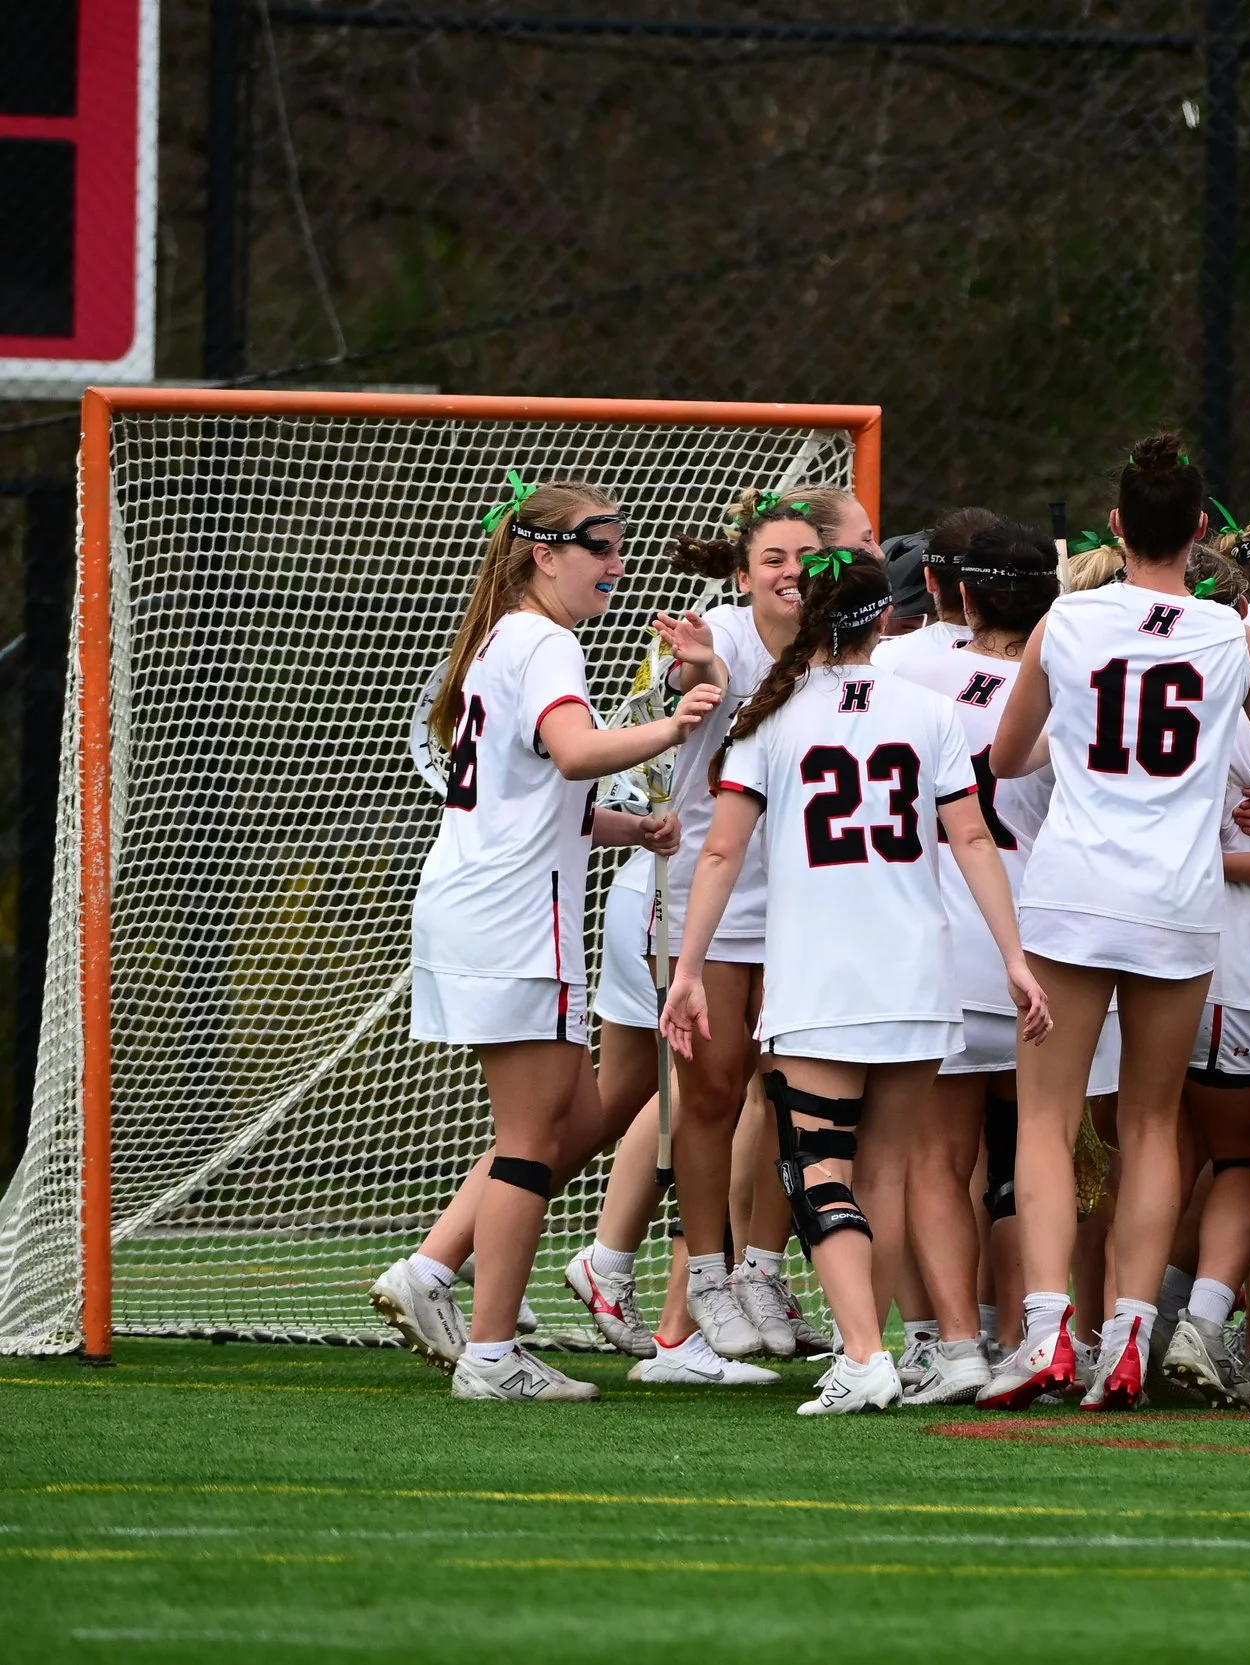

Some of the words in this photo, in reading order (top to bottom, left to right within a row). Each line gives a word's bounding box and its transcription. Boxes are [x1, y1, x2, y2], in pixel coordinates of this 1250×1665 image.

[534, 532, 558, 541] GAIT
[930, 554, 946, 564] STX
[1138, 603, 1184, 638] H
[838, 680, 875, 713] H
[956, 671, 1006, 708] H
[1087, 657, 1204, 777] 16
[610, 783, 620, 798] STX
[800, 742, 924, 868] 23
[655, 889, 663, 921] GAIT
